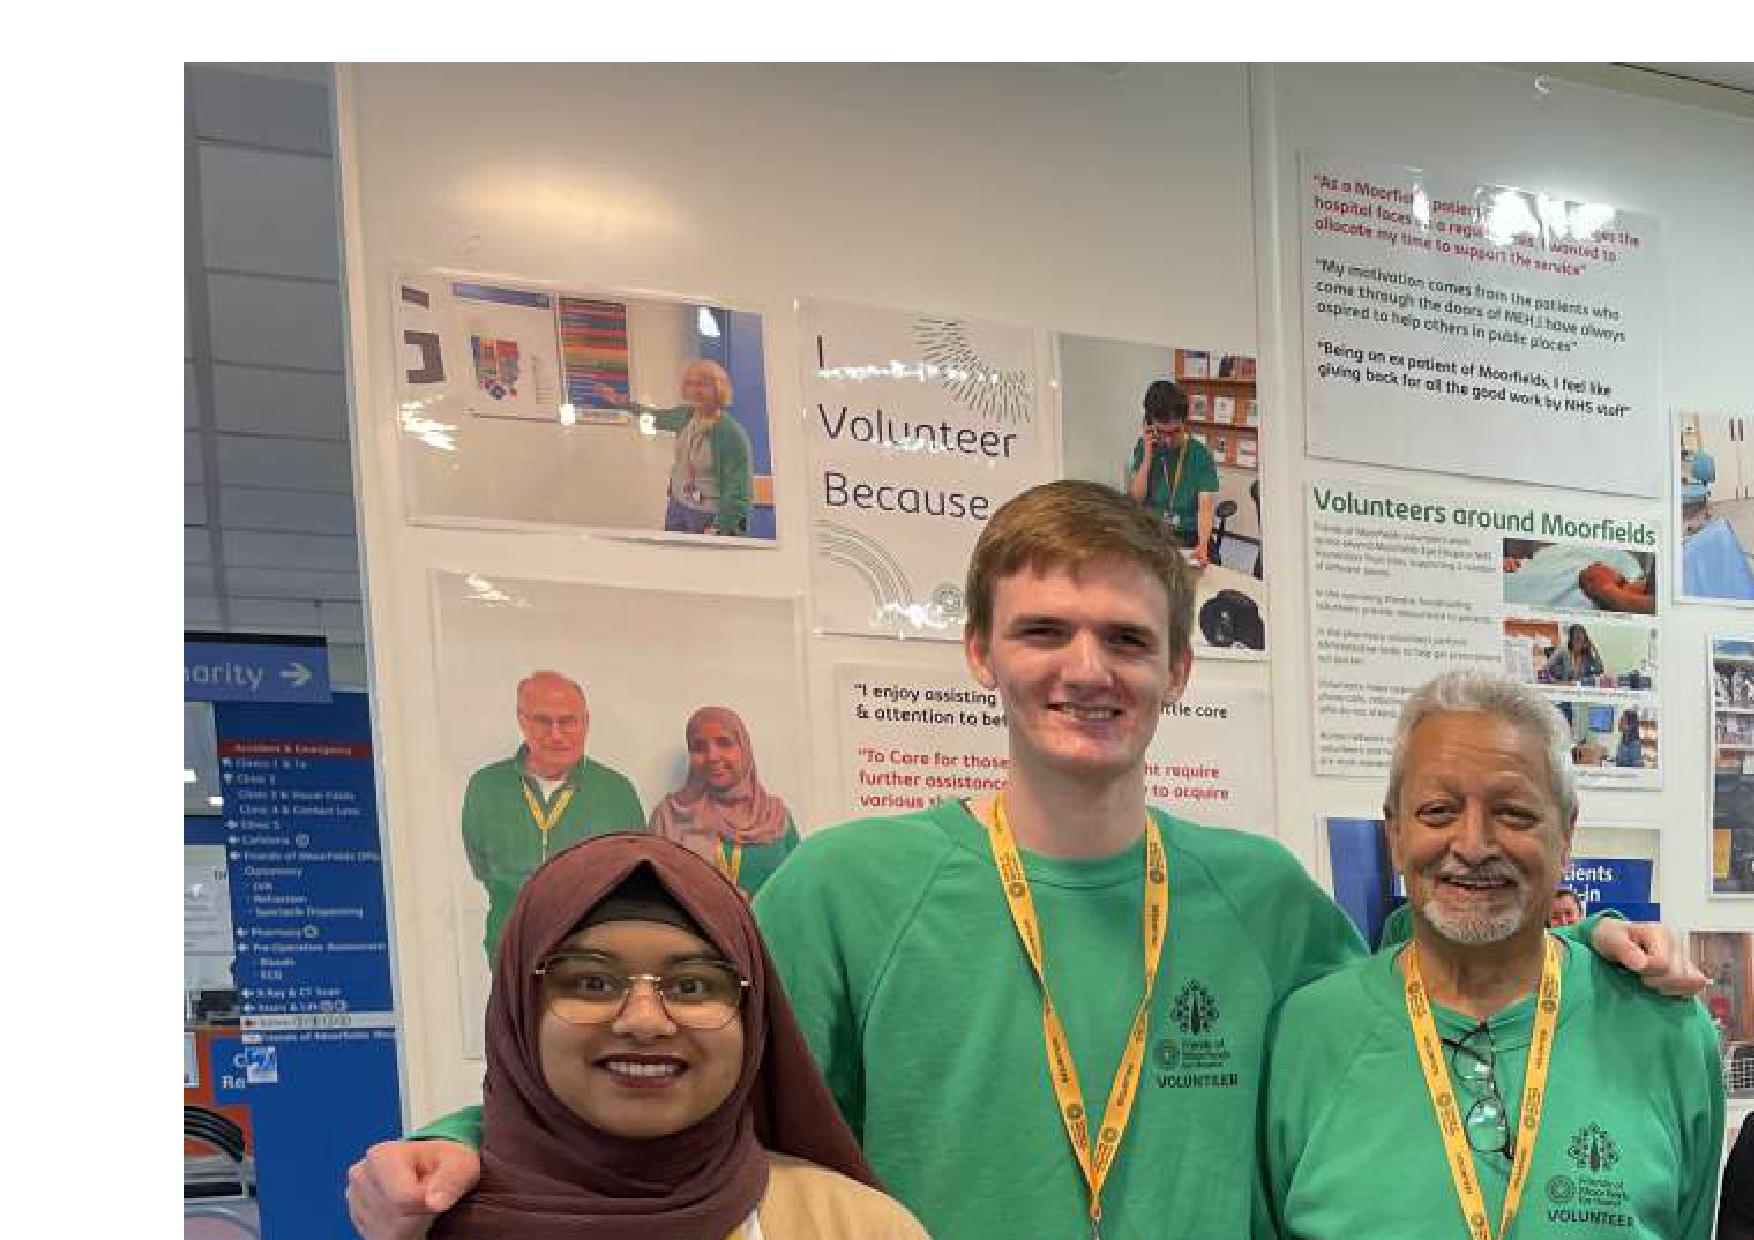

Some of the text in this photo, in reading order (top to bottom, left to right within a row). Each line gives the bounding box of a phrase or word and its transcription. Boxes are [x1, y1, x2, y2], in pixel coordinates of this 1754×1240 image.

[1315, 196, 1371, 216] hospital
[1316, 216, 1371, 238] allocate
[1453, 244, 1506, 264] support
[1316, 282, 1353, 297] come
[1359, 285, 1414, 308] through
[1419, 297, 1441, 311] the
[1444, 301, 1483, 317] doors
[1580, 326, 1626, 344] always
[1348, 267, 1424, 288] motivation
[1428, 281, 1472, 297] comes
[1475, 284, 1507, 304] from
[1511, 292, 1531, 307] the
[1534, 299, 1588, 316] patients
[1391, 311, 1421, 331] help
[1423, 319, 1470, 337] others
[1317, 363, 1361, 383] giving
[1366, 366, 1398, 385] back
[1402, 373, 1421, 388] for
[1425, 378, 1442, 392] all
[1446, 380, 1470, 395] the
[1473, 387, 1506, 401] good
[1509, 391, 1541, 406] work
[1545, 397, 1562, 412] by
[1564, 399, 1594, 414] NHS
[1368, 350, 1386, 364] an
[1407, 357, 1458, 375] patient
[1460, 362, 1475, 377] of
[1562, 378, 1586, 394] feel
[1590, 381, 1612, 397] like
[818, 403, 1018, 458] Volunteer
[823, 471, 990, 521] Because
[1313, 486, 1656, 546] Volunteers around Moorfields
[184, 662, 264, 693] arity
[873, 685, 920, 704] enjoy
[924, 687, 997, 707] assisting
[855, 703, 1228, 726] & attention to care
[858, 771, 921, 790] further
[1152, 784, 1169, 798] to
[889, 749, 930, 766] Care
[934, 750, 959, 767] for
[1163, 766, 1220, 782] require
